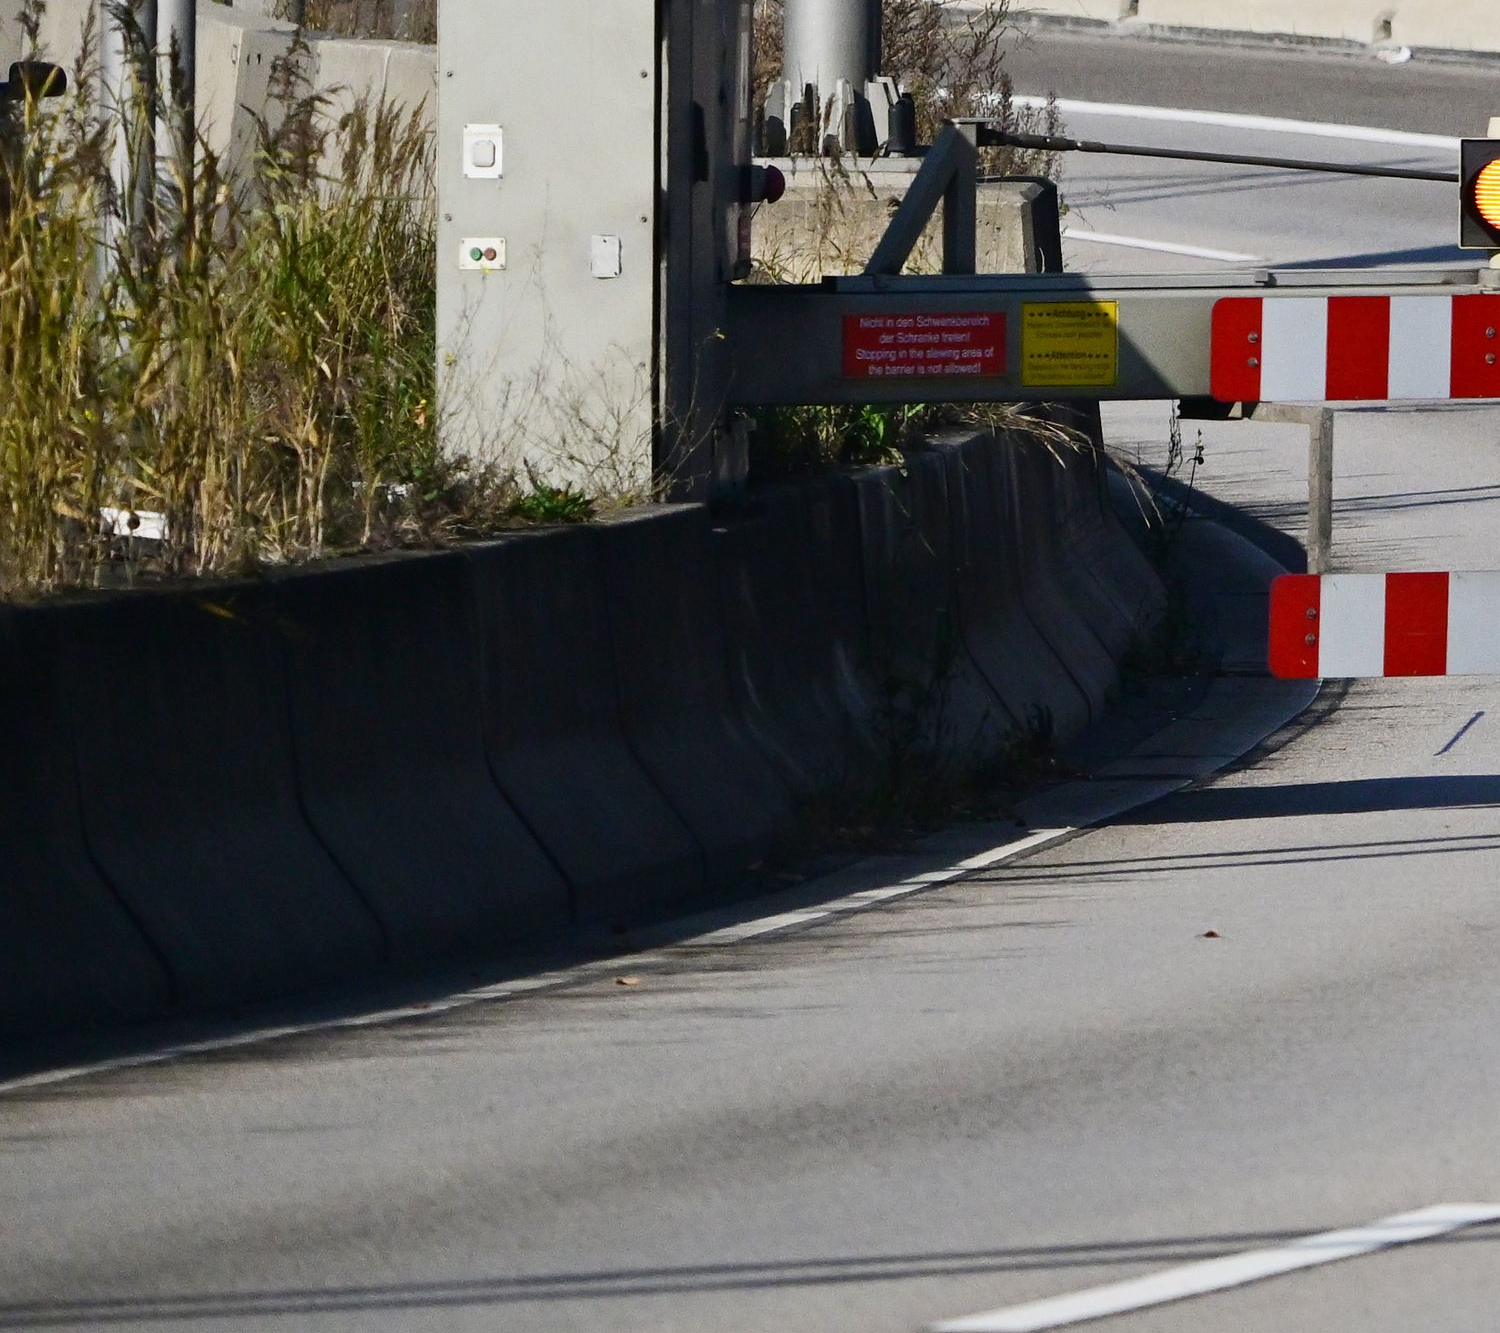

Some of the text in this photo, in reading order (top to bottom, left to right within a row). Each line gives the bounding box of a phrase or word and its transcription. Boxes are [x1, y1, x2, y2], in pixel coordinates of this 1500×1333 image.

[859, 315, 990, 328] Nicht in den Schwenkbereich
[879, 333, 895, 344] der
[897, 331, 940, 343] Schranke
[855, 346, 995, 361] Stopping in the slewing area of
[1050, 351, 1087, 360] Attention
[868, 362, 982, 375] the barrier is not allowed!
